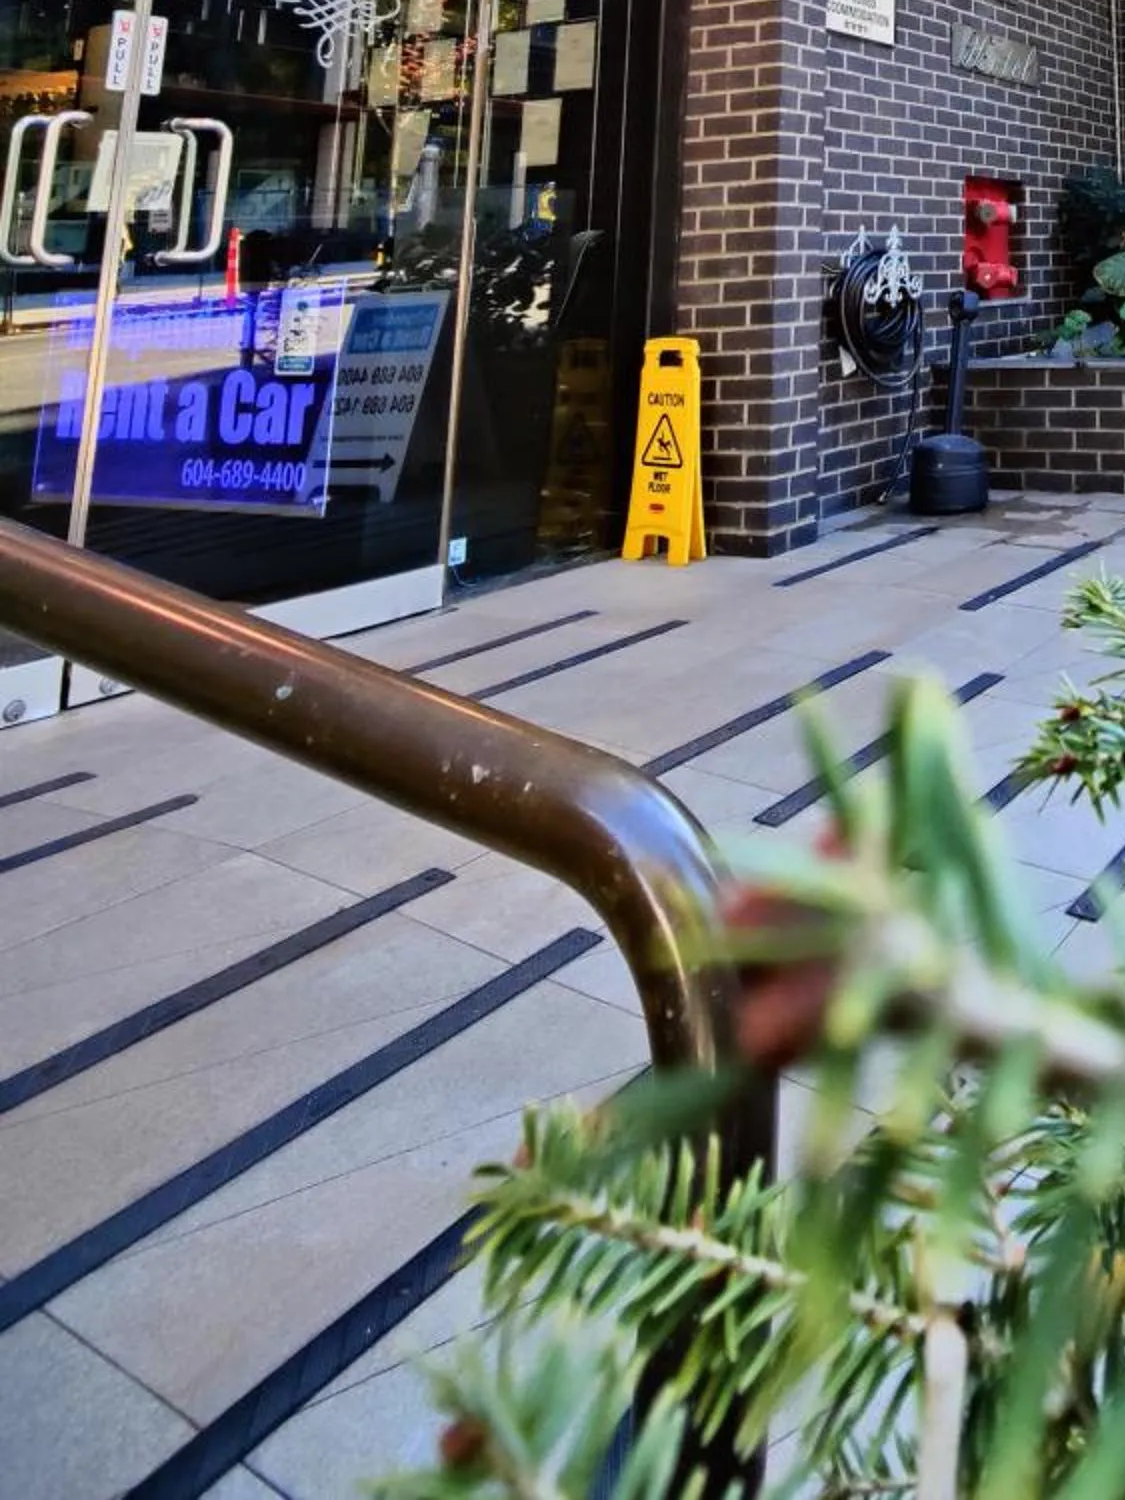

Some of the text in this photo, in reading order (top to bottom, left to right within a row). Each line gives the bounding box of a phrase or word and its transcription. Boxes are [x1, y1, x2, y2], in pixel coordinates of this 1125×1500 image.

[175, 386, 207, 441] a
[218, 368, 315, 446] Car
[647, 392, 685, 407] CAUTION
[181, 457, 306, 491] 604-689-4400
[653, 470, 669, 482] WET
